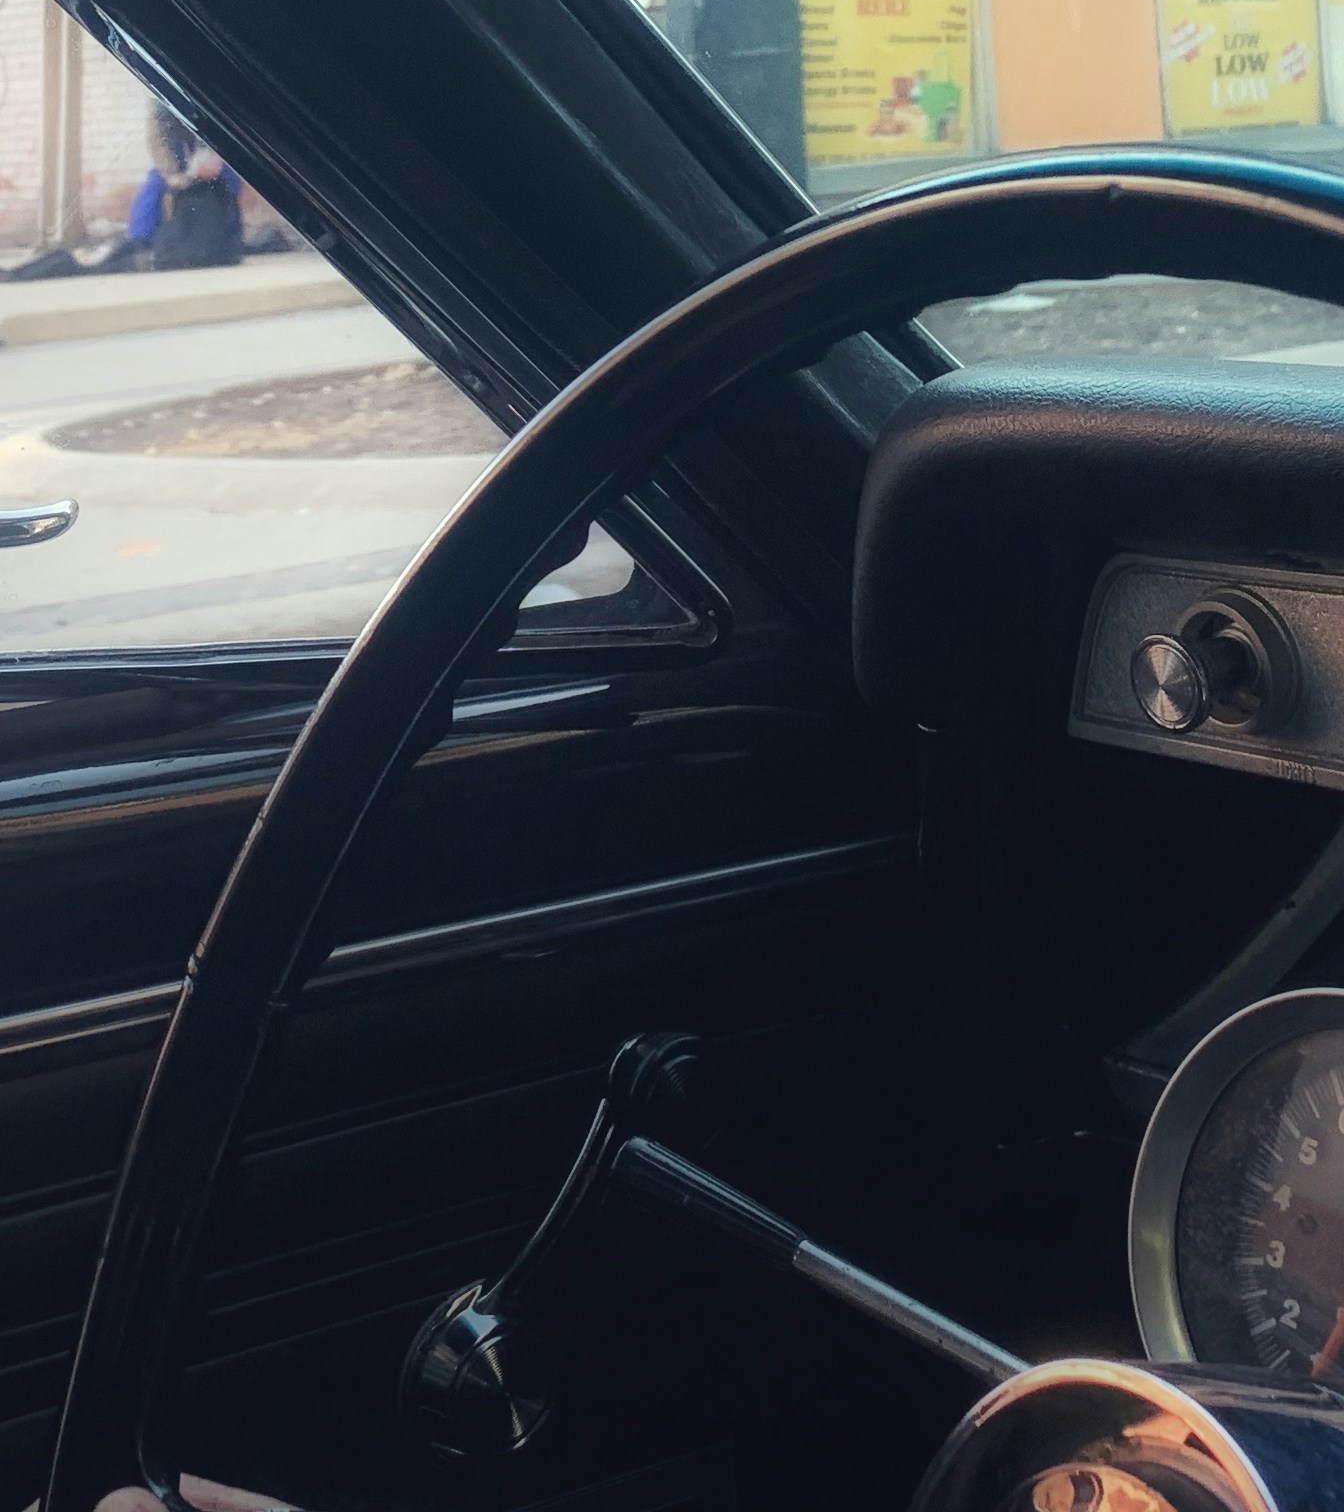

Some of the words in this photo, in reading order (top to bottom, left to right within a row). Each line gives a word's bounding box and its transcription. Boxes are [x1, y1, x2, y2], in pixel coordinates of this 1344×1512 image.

[1223, 34, 1261, 50] LOW
[1214, 52, 1270, 77] LOW
[1209, 76, 1270, 106] LOW
[1298, 1137, 1319, 1165] 5
[1271, 1184, 1293, 1212] 4
[1266, 1239, 1286, 1269] 3
[1279, 1298, 1301, 1329] 2
